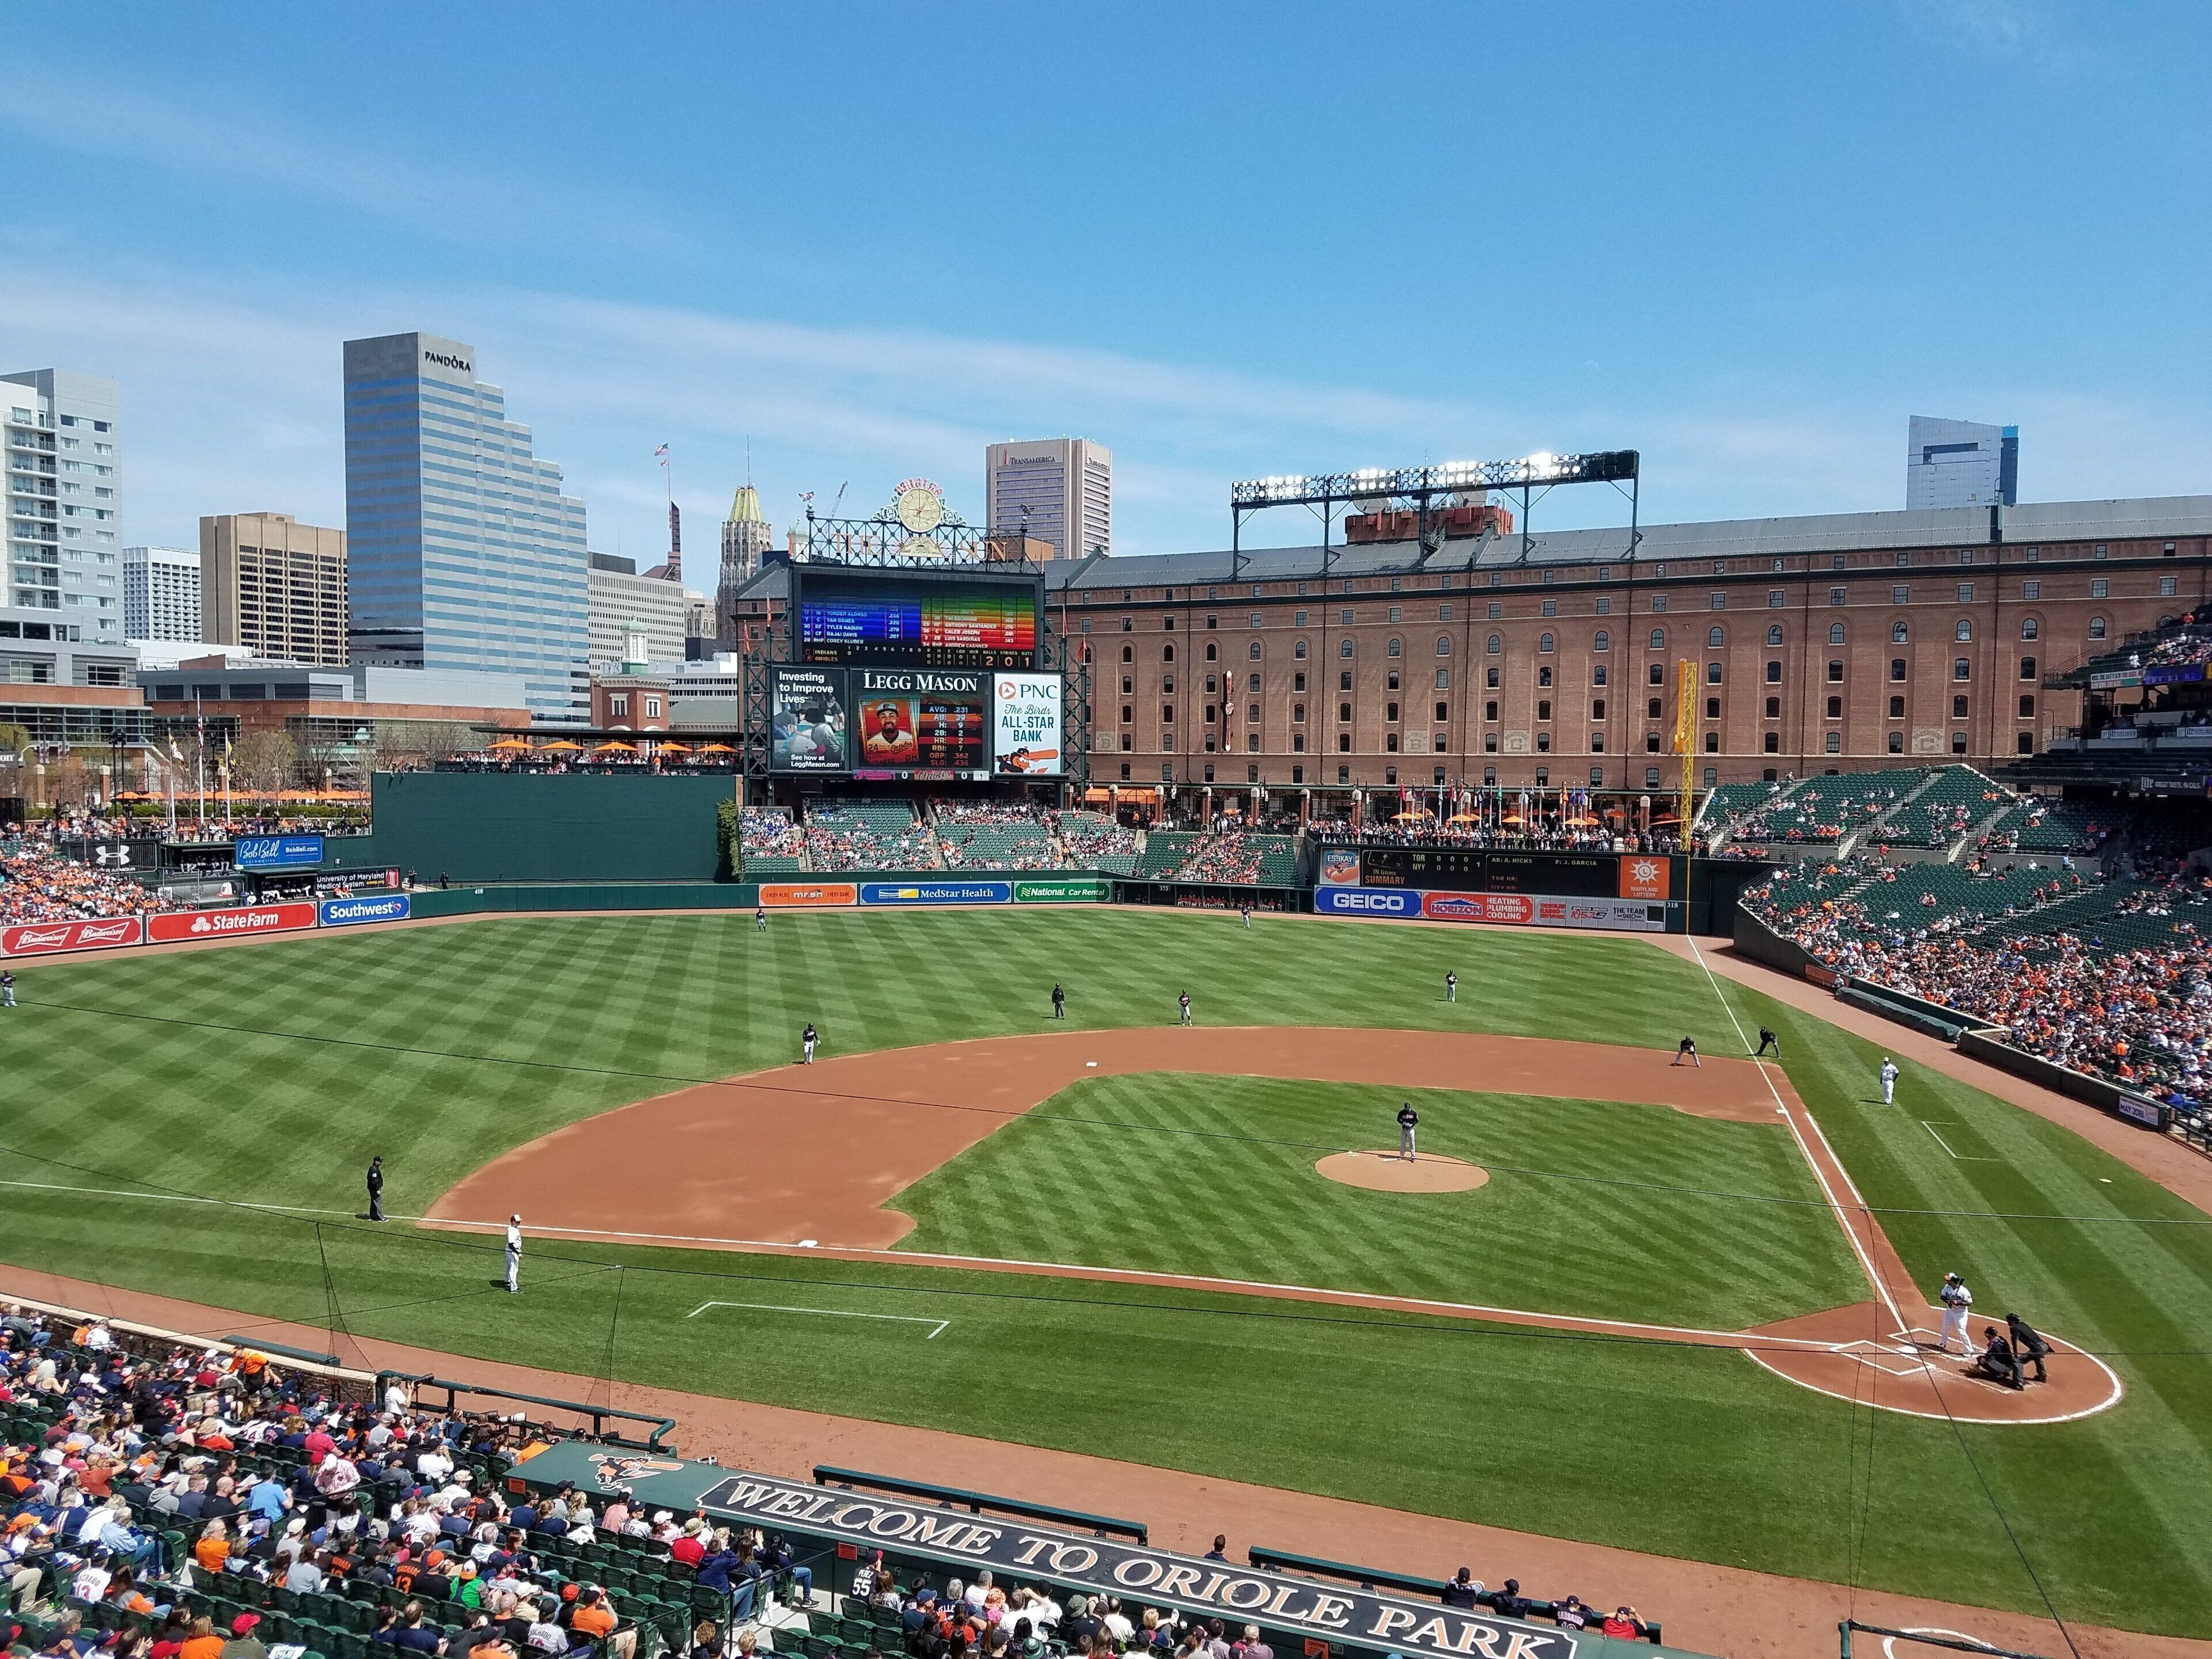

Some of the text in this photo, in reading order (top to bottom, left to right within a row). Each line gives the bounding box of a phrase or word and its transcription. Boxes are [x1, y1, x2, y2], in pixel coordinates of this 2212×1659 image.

[1009, 456, 1055, 465] TRANSAMERICA
[831, 533, 1008, 562] THE SUN
[986, 656, 994, 666] 2
[1005, 657, 1013, 666] 0
[1024, 657, 1029, 666] 1
[779, 671, 824, 683] Investing
[863, 673, 978, 691] LEGG MASON
[793, 683, 834, 694] Improve
[1018, 684, 1058, 699] PNC
[1005, 704, 1051, 715] The Birds
[1002, 716, 1054, 729] ALL-STAR
[1013, 730, 1042, 742] BANK
[868, 741, 912, 755] 24 Orioles
[902, 771, 908, 779] 0
[240, 840, 258, 859] Bob
[258, 839, 280, 858] Bell
[1327, 854, 1353, 863] ESSKAY
[1412, 854, 1425, 862] TOR
[1412, 863, 1425, 871] NYY
[317, 874, 348, 882] University
[357, 872, 385, 881] Maryland
[1365, 875, 1406, 885] SUMMARY
[317, 882, 341, 890] Medical
[921, 888, 994, 898] MedStar Health
[1031, 888, 1064, 896] National
[1333, 893, 1404, 911] GEICO
[1486, 897, 1521, 905] HEATING
[329, 902, 393, 919] Southwest
[1431, 904, 1482, 914] HORIZON
[1486, 904, 1527, 912] PLUMBING
[1627, 908, 1645, 916] TEAM
[1486, 911, 1521, 920] COOLING
[21, 926, 124, 945] Budweiser Budweiser
[2120, 1103, 2131, 1113] MAY
[727, 1480, 1555, 1659] WELCOME TO ORIOLE PARK
[858, 1569, 874, 1579] PEREZ
[395, 1575, 412, 1594] 13
[852, 1578, 872, 1596] 55
